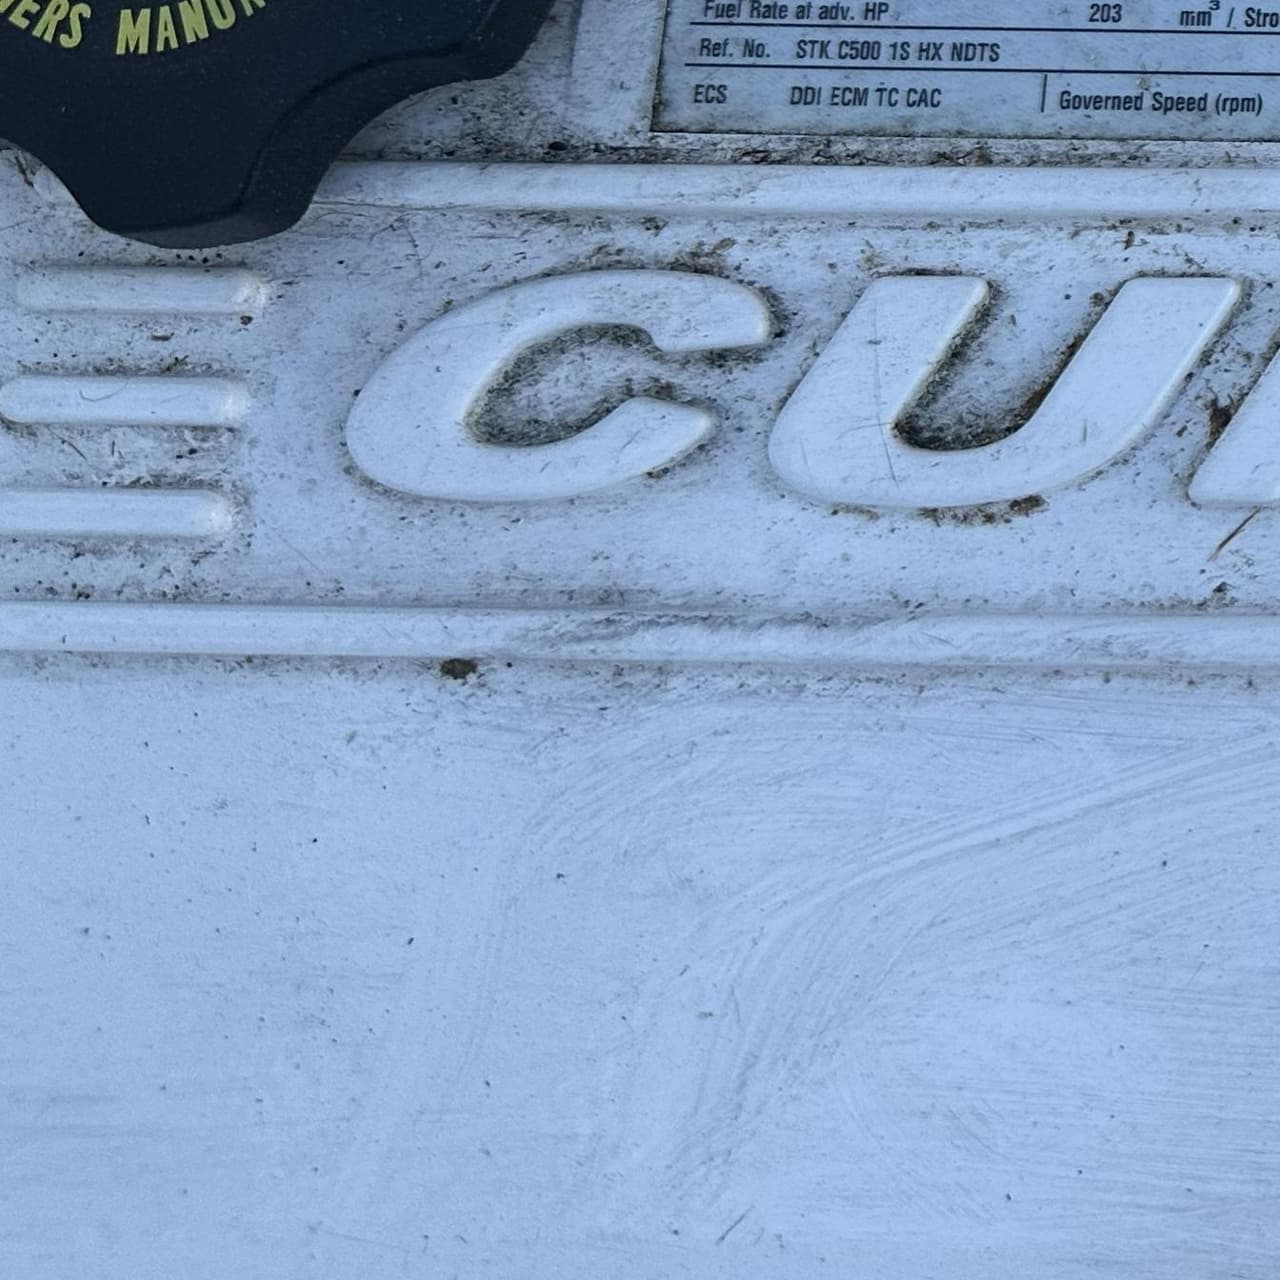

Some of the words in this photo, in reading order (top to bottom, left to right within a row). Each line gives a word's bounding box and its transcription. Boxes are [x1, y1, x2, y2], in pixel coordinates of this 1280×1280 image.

[704, 0, 743, 19] Fuel
[749, 0, 788, 19] Rate
[794, 2, 813, 20] at
[818, 2, 854, 20] adv.
[864, 2, 889, 21] HP
[1088, 3, 1122, 23] 203
[699, 38, 733, 57] Ref.
[742, 39, 770, 58] No.
[796, 39, 832, 59] STK
[838, 40, 881, 60] C500
[889, 41, 910, 61] 1S
[918, 42, 944, 61] HX
[950, 42, 1000, 62] NDTS
[693, 84, 727, 104] ECS
[789, 86, 822, 106] DDI
[829, 87, 869, 106] ECM
[874, 87, 899, 107] TC
[906, 88, 942, 108] CAC
[1059, 90, 1144, 111] Governed
[1151, 92, 1208, 115] Speed
[1215, 93, 1263, 117] (rpm)
